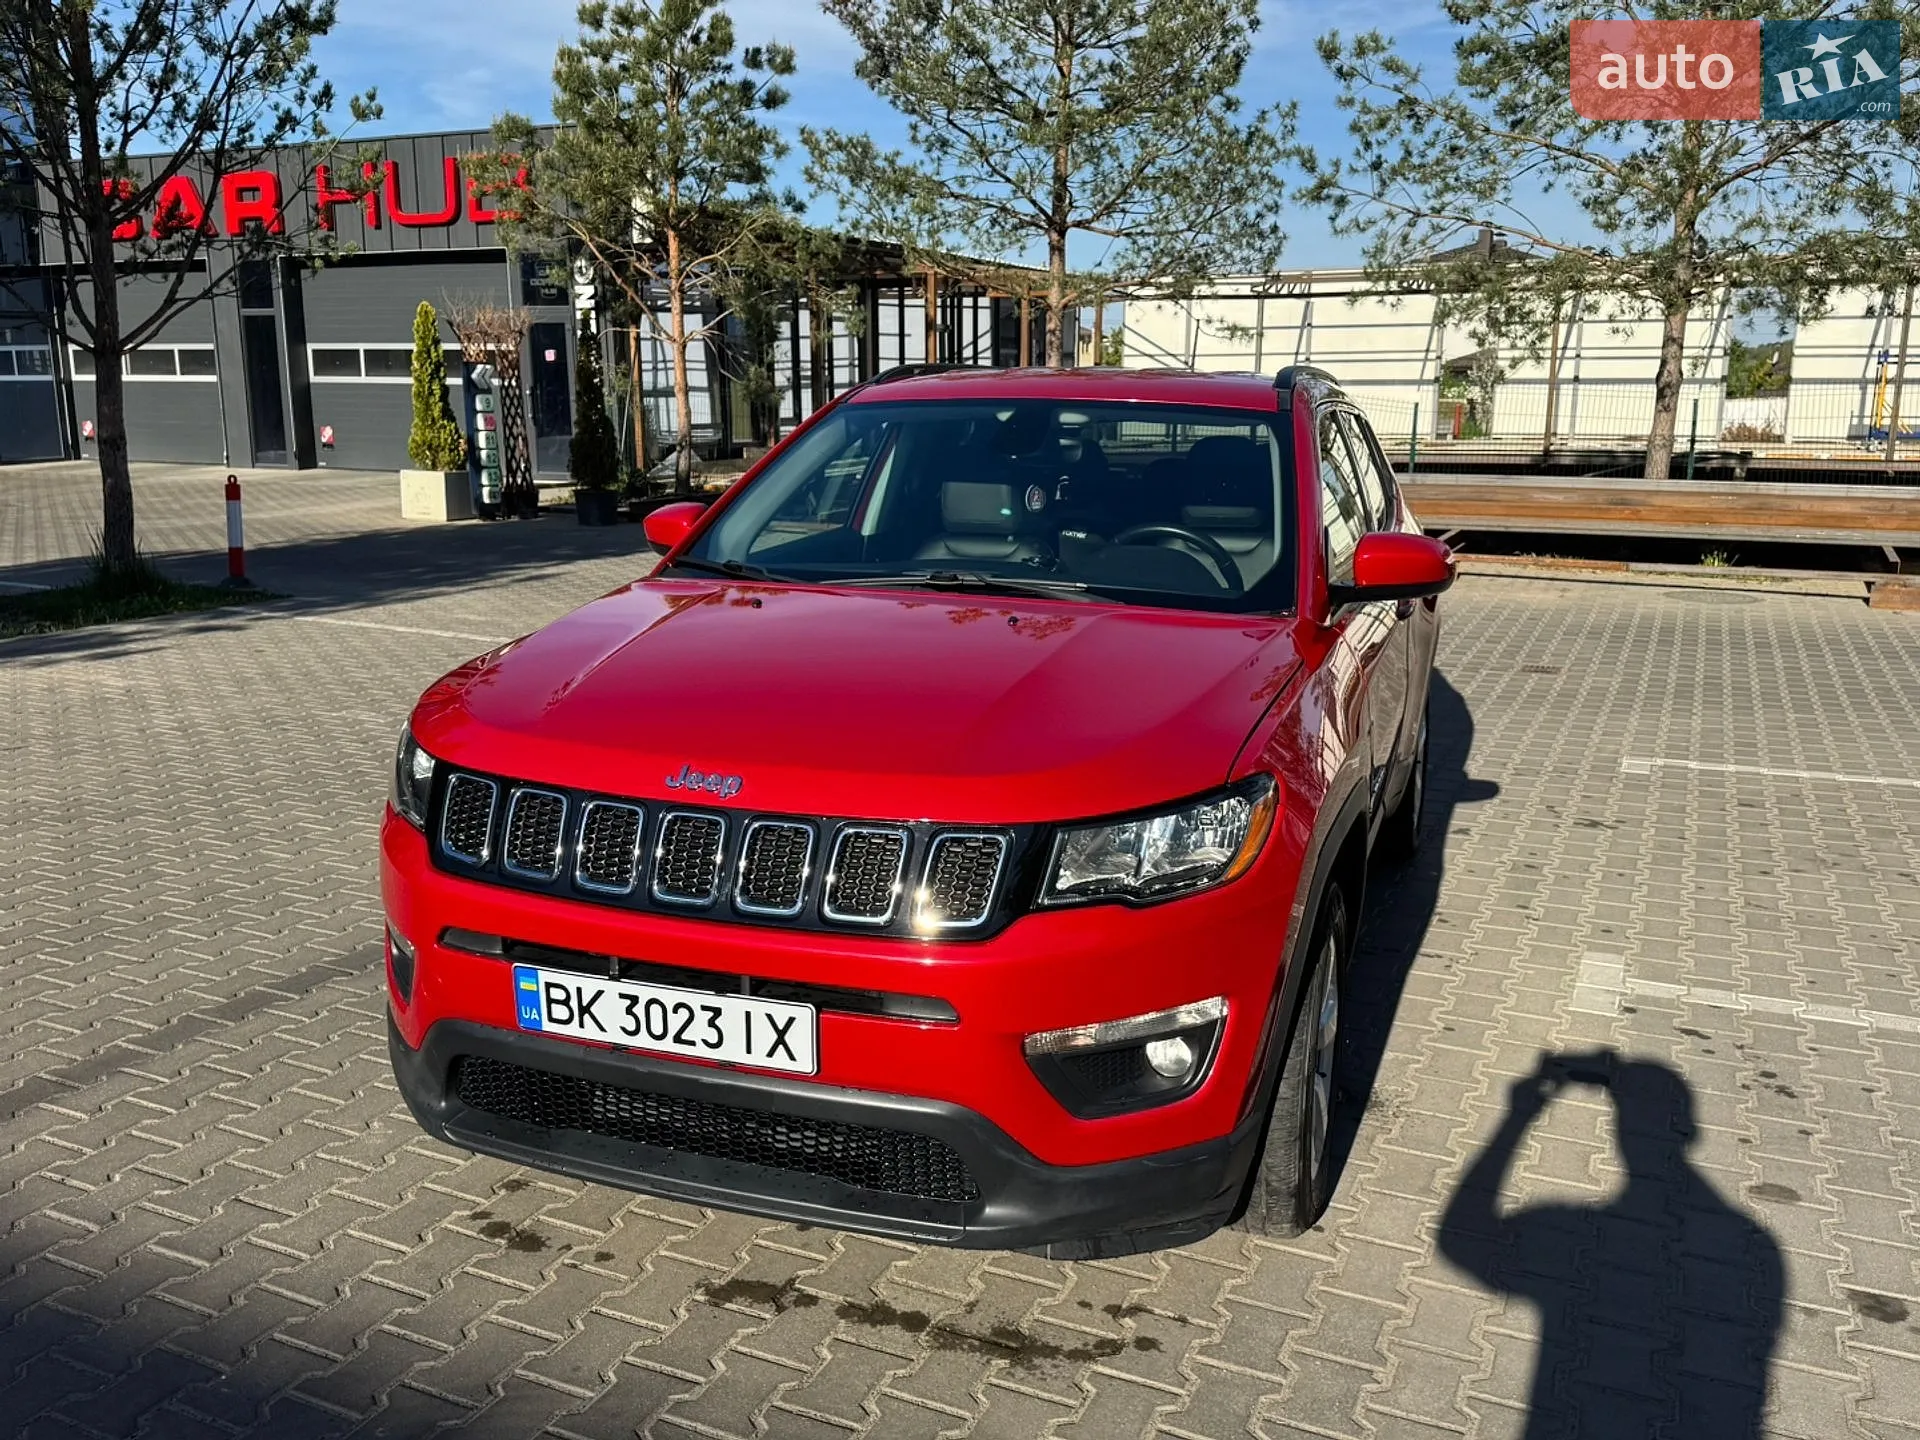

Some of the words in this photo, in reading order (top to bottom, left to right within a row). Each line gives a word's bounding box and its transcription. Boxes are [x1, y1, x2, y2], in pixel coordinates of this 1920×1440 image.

[665, 764, 743, 799] Jeep
[522, 1006, 540, 1021] UA
[545, 981, 608, 1034] BK
[618, 992, 725, 1050] 3023
[745, 1010, 798, 1062] IX
